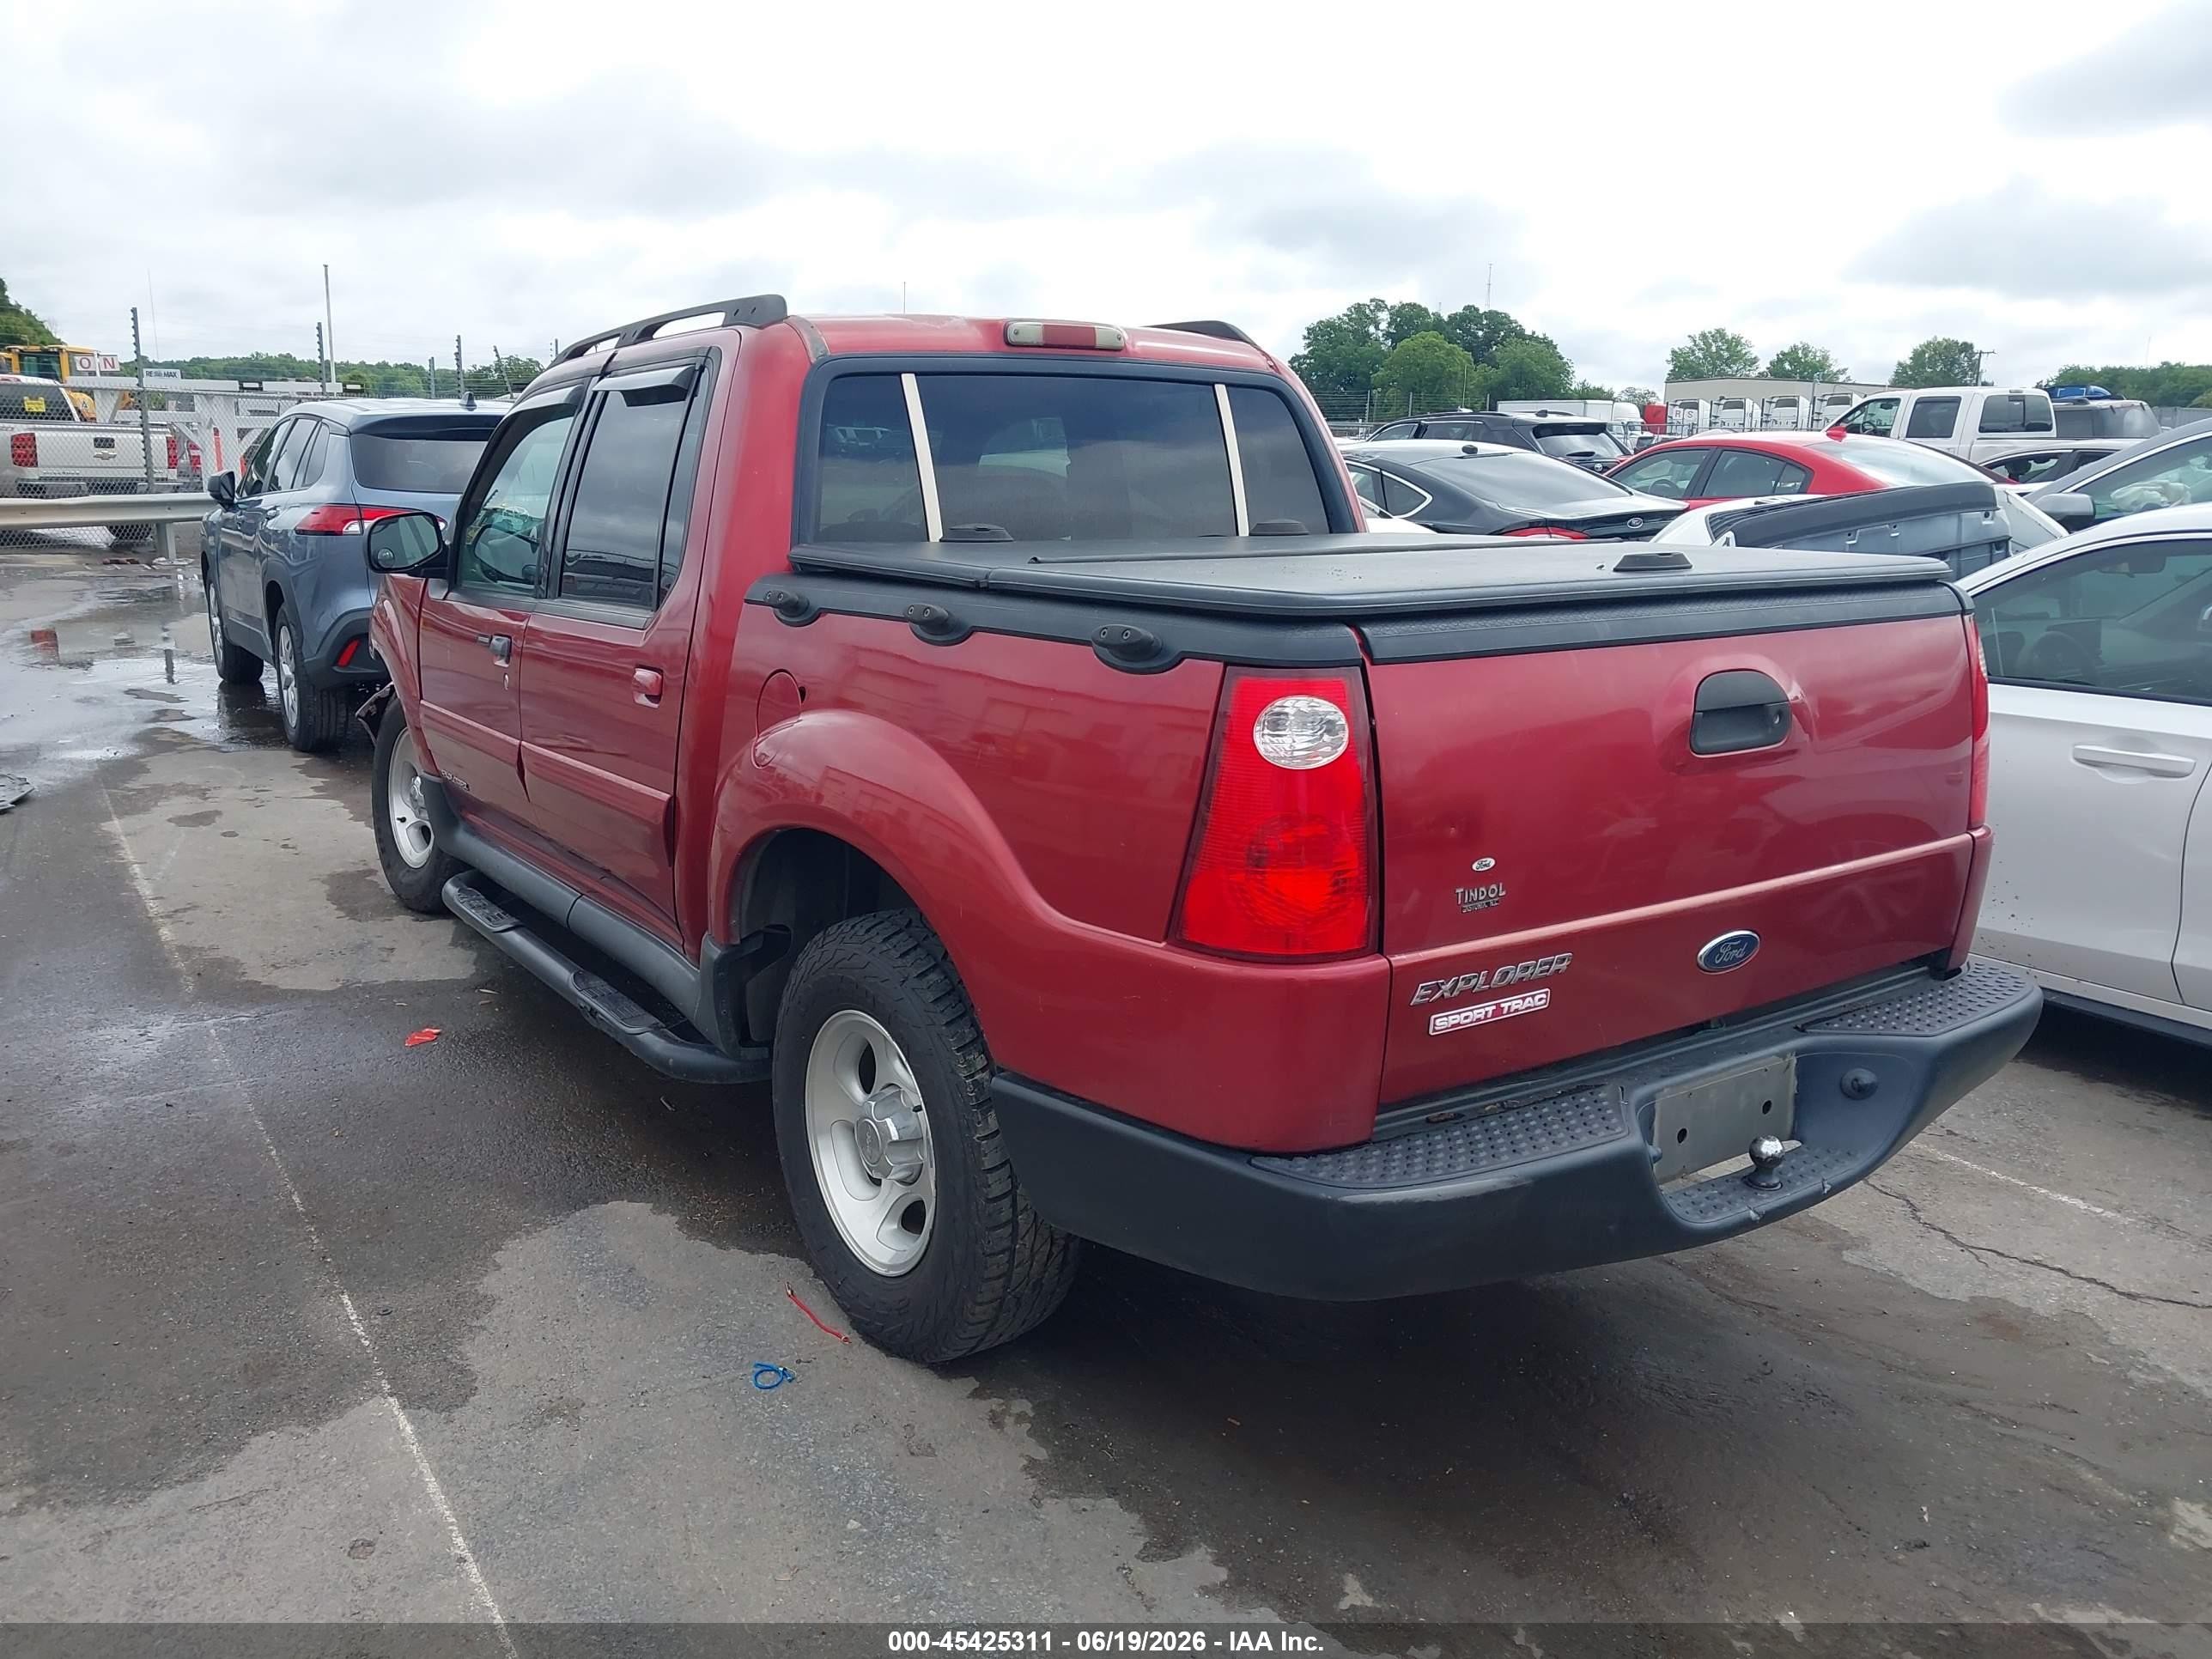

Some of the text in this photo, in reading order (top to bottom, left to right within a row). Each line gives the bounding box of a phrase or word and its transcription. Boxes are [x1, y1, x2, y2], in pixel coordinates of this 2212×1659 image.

[1475, 860, 1492, 870] Ford
[1455, 882, 1506, 904] TINDOL
[1715, 939, 1748, 964] Ford
[1410, 952, 1573, 1006] EXPLORER
[1434, 993, 1547, 1030] SPORT TRAC
